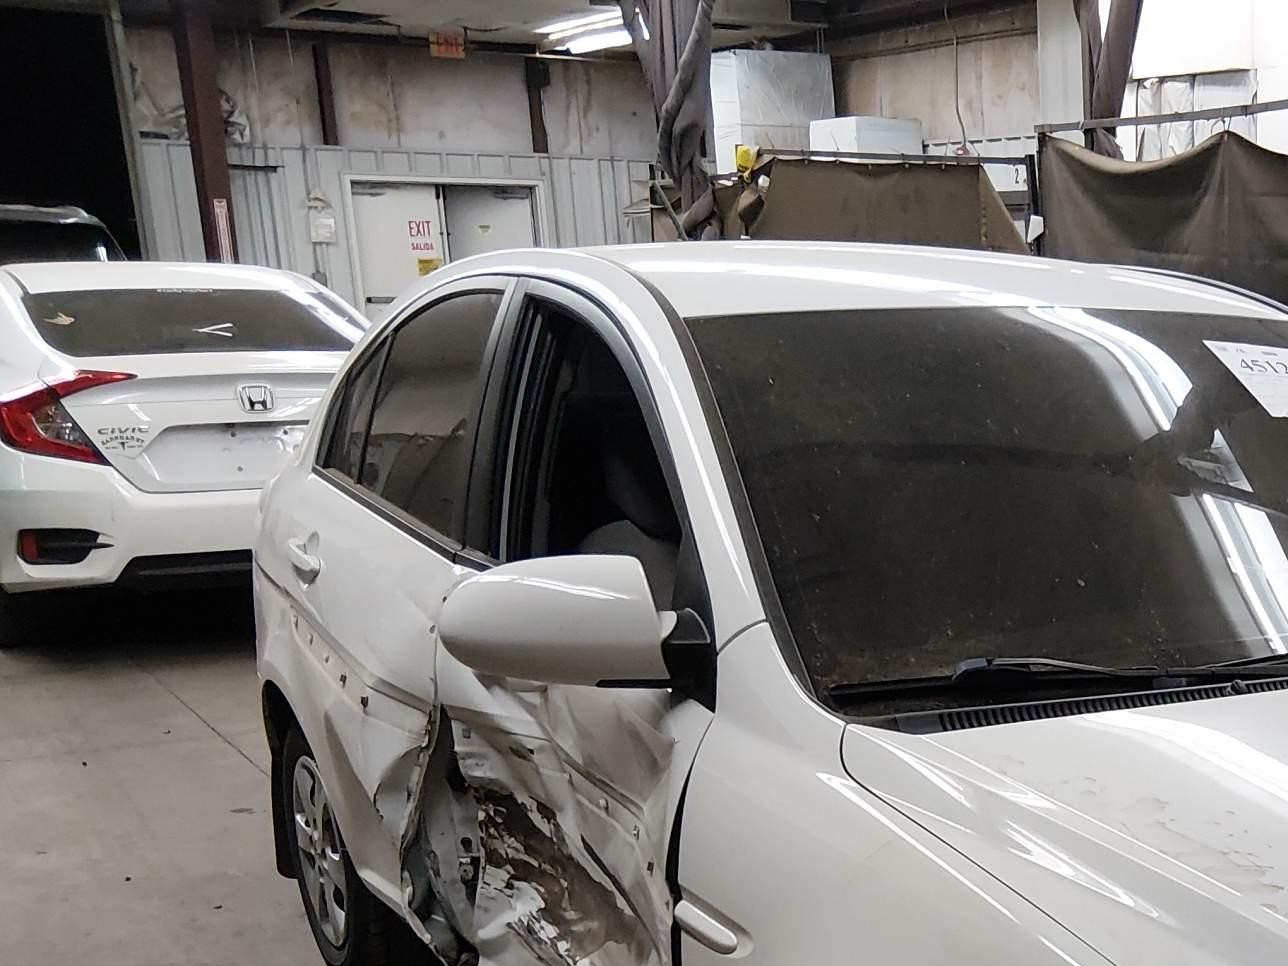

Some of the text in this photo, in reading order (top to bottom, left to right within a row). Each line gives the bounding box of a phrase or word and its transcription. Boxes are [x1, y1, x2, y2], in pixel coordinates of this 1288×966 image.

[1014, 168, 1020, 184] 2
[408, 220, 432, 237] EXIT
[411, 242, 434, 251] SALIDA
[97, 427, 150, 435] CIVIC
